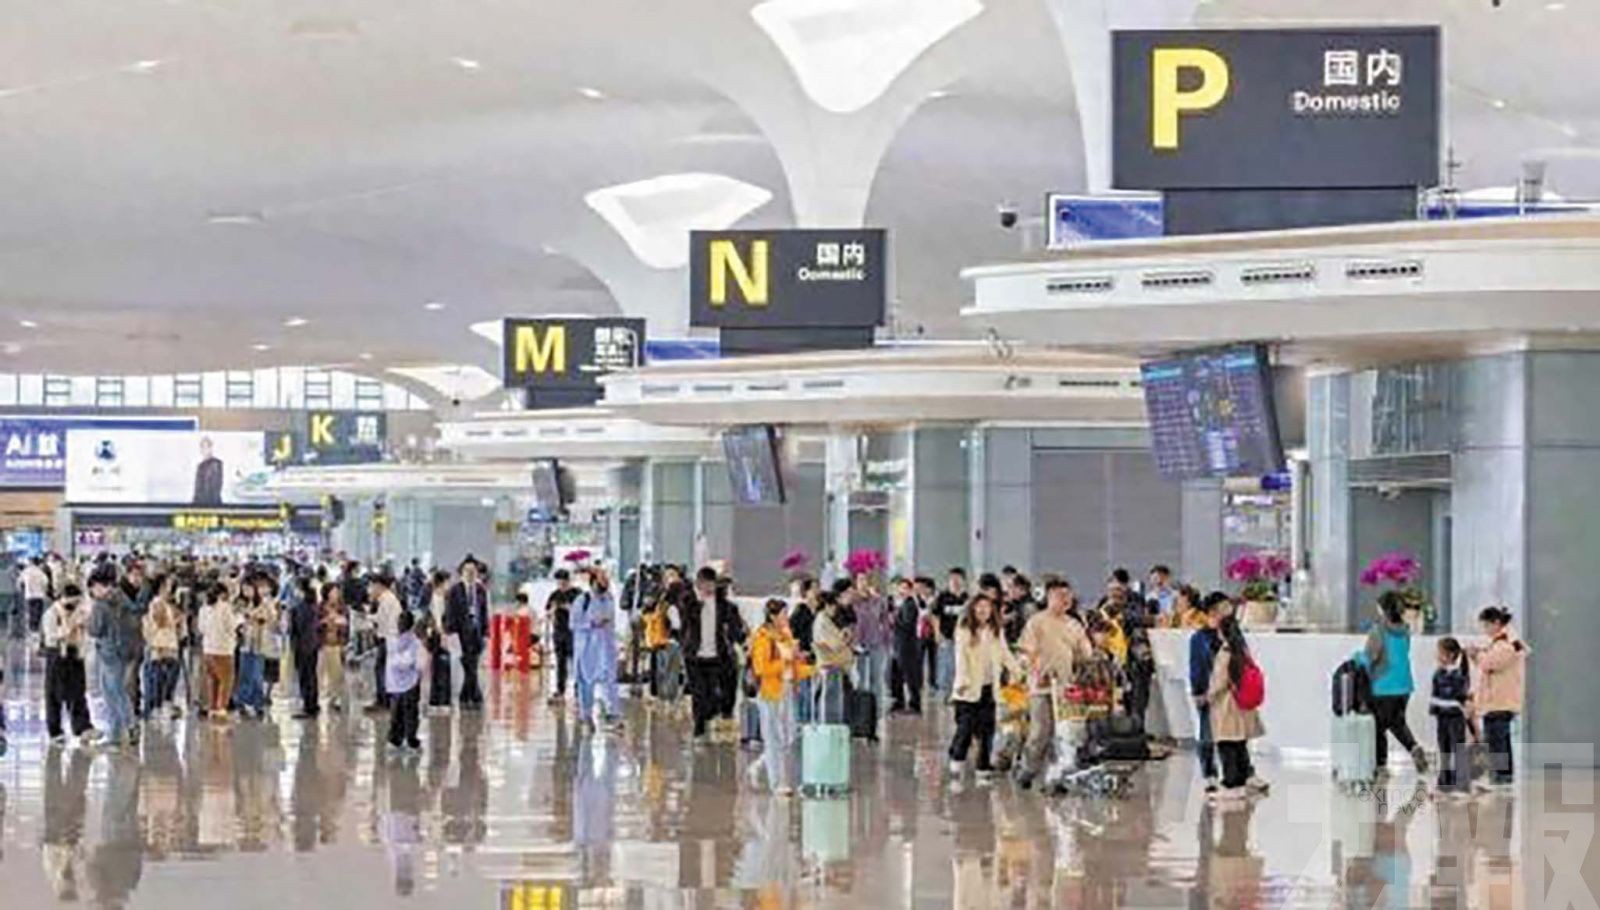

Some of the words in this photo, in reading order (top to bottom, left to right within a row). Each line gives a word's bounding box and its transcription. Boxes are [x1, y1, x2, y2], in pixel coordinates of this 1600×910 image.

[1324, 48, 1402, 86] 国内
[1151, 47, 1229, 149] P
[1293, 91, 1401, 111] Domestic
[816, 241, 865, 266] 国内
[709, 239, 769, 306] N
[798, 267, 866, 281] Domestic
[514, 325, 566, 373] M
[311, 413, 336, 444] K
[272, 435, 291, 460] J
